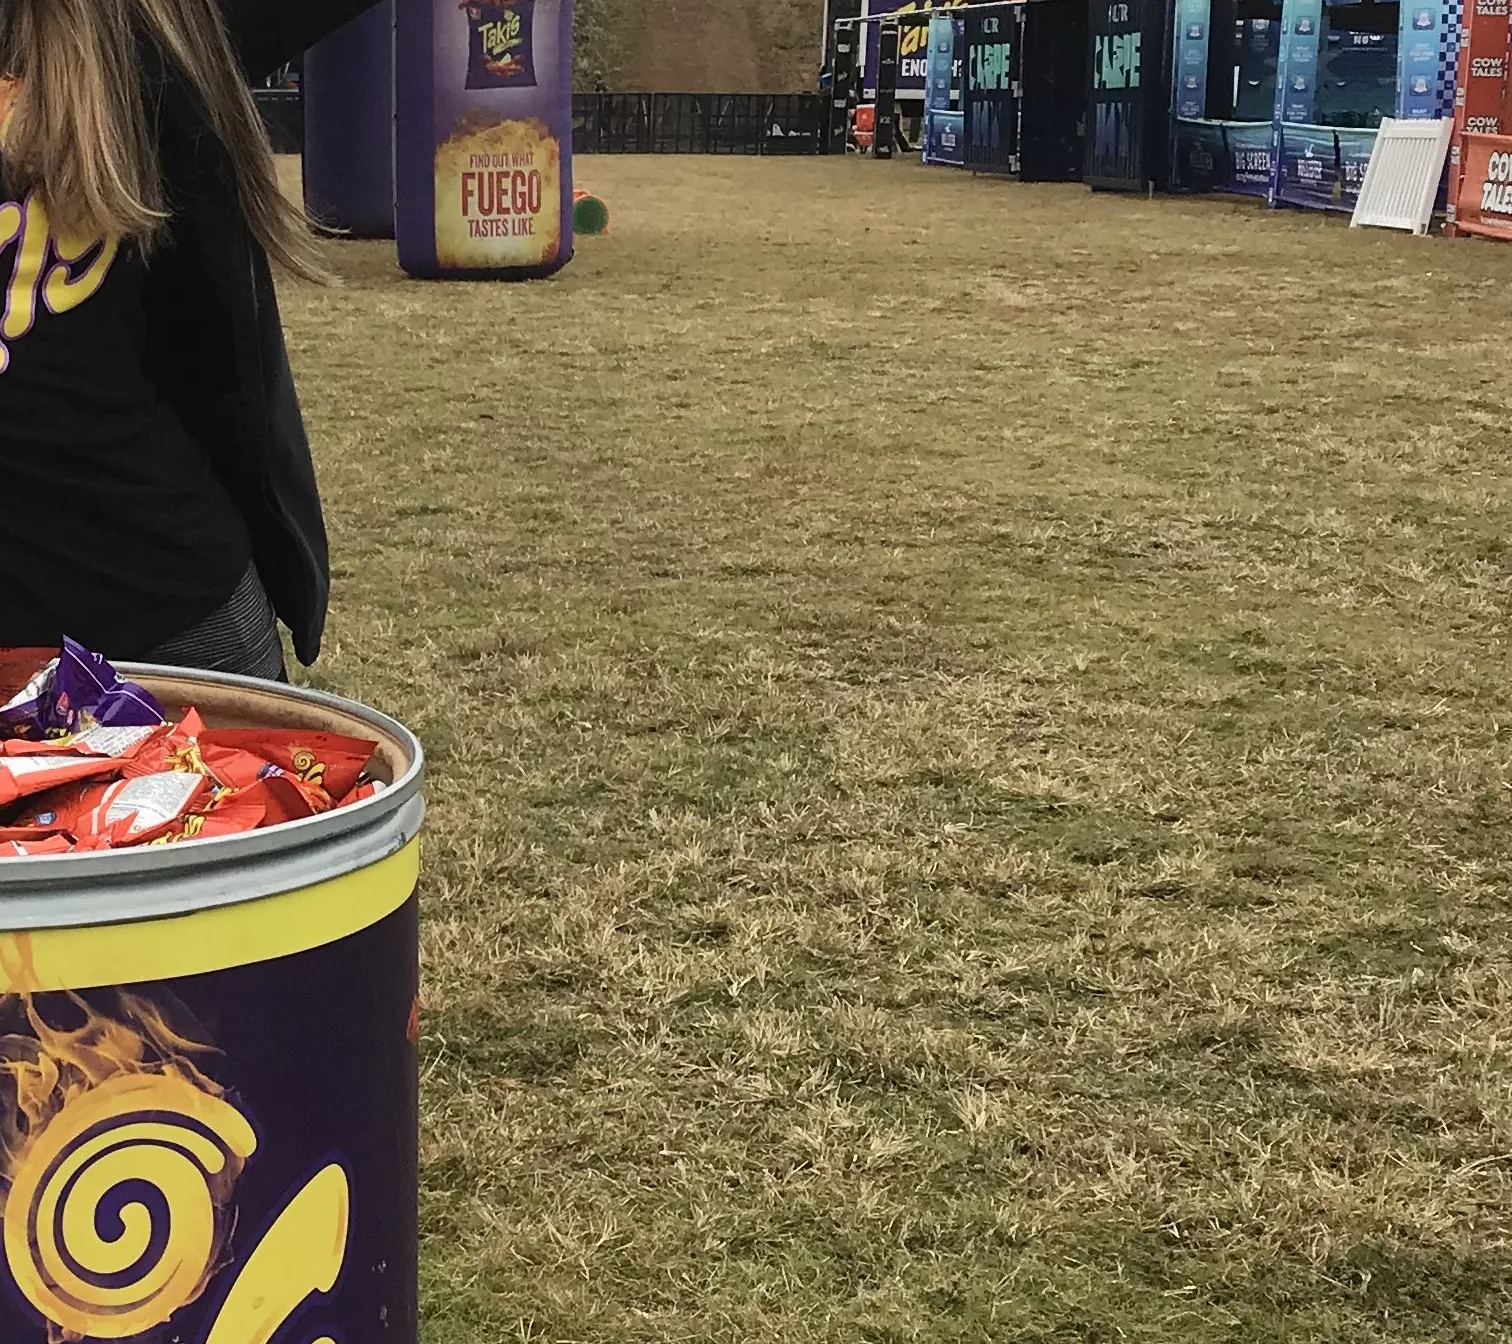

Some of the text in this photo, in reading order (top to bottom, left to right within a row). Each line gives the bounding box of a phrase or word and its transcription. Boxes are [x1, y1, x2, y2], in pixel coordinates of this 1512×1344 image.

[1476, 5, 1508, 15] TALES
[1472, 57, 1503, 67] COW
[1471, 67, 1503, 77] TALES
[1467, 116, 1498, 126] COW
[470, 152, 534, 168] FIND OUT WHAT
[461, 169, 542, 216] FUEGO
[467, 217, 536, 238] TASTES LIKE
